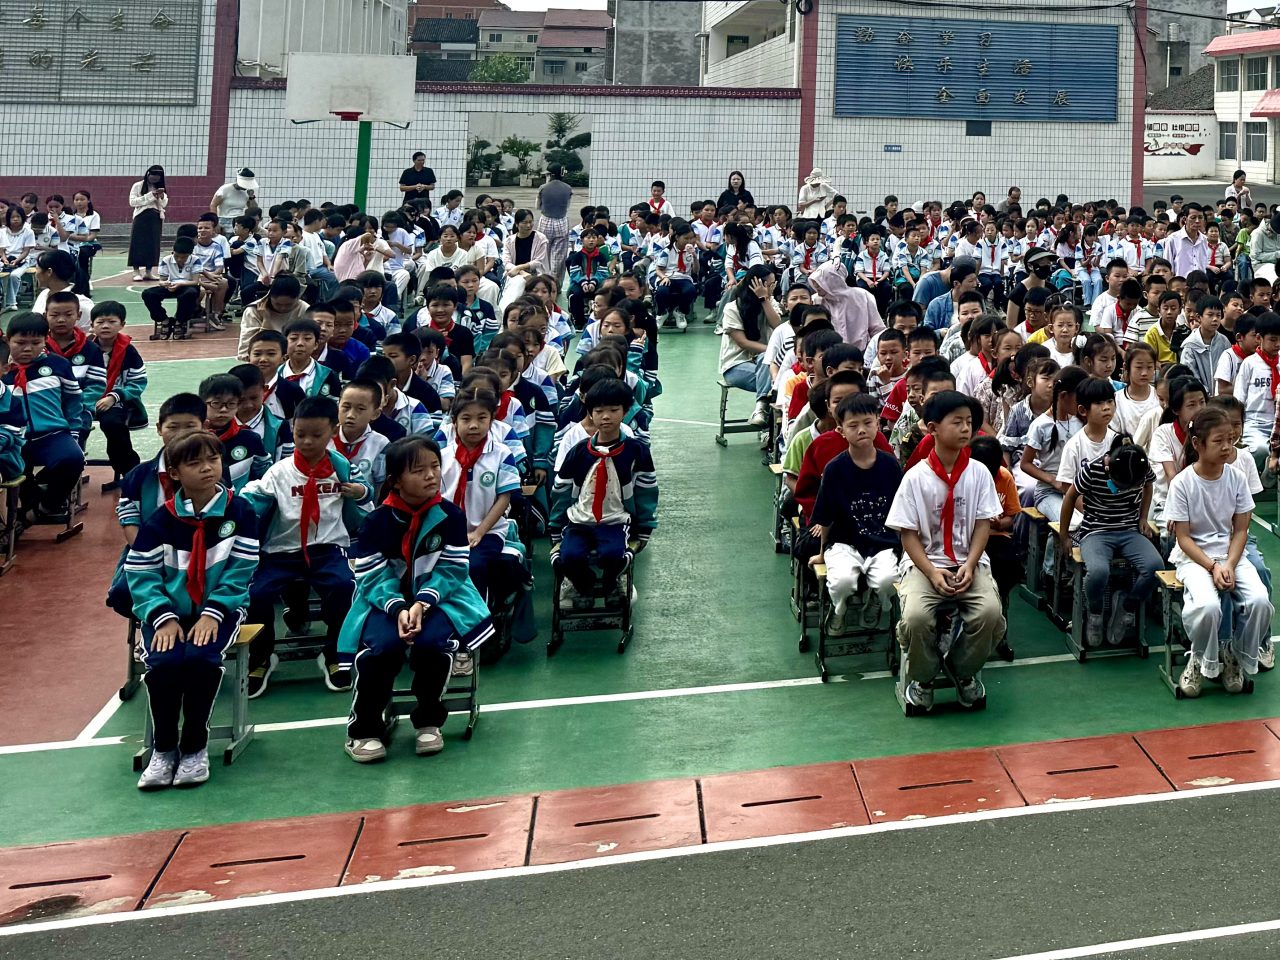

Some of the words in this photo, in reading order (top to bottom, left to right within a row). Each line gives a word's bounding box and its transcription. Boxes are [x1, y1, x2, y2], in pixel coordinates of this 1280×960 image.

[0, 4, 175, 32] 每个生命
[855, 26, 993, 48] 勤奋学习
[0, 47, 156, 74] 的光芒
[894, 54, 1033, 76] 快乐生活
[936, 85, 1070, 106] 全面发展
